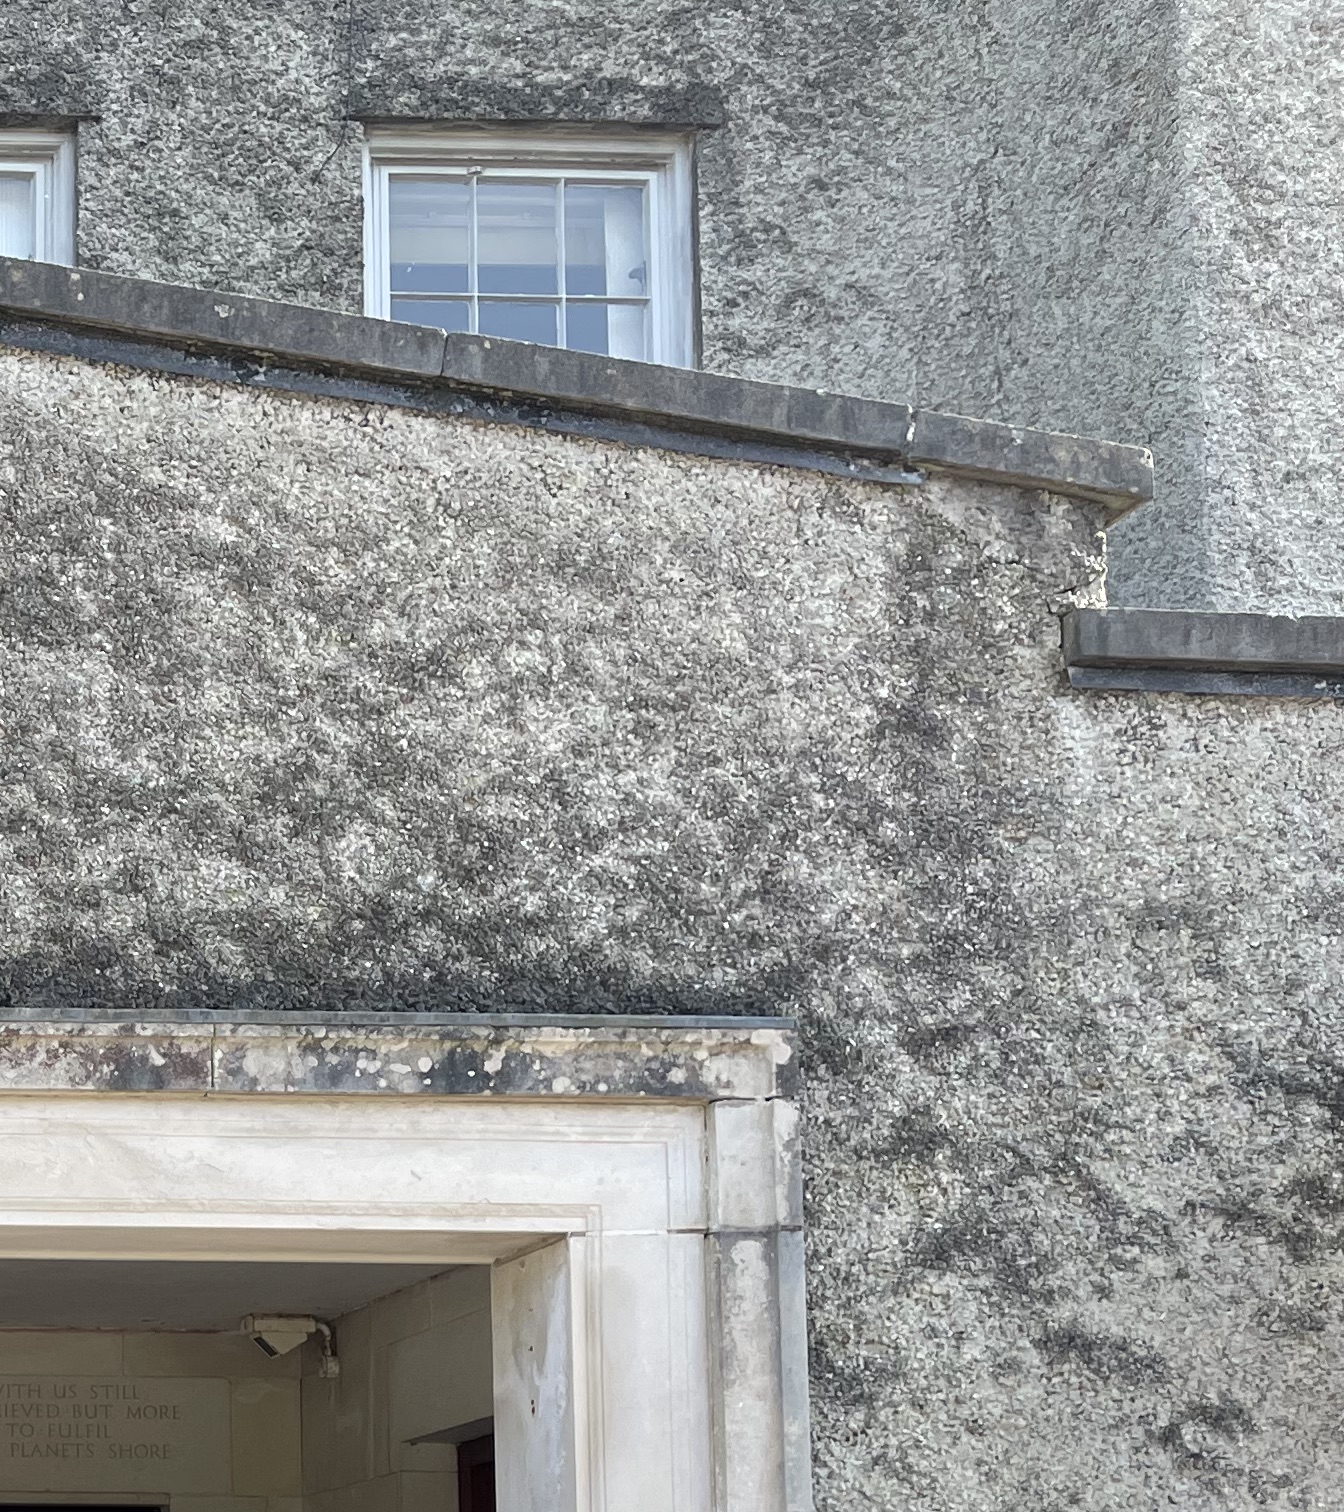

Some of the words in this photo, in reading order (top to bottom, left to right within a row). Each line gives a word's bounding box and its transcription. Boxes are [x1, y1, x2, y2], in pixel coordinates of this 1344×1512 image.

[53, 1384, 77, 1399] US
[72, 1404, 114, 1420] BUT
[126, 1405, 181, 1421] MORE
[5, 1422, 35, 1438] TO
[47, 1423, 113, 1439] FULFIL
[108, 1443, 172, 1460] SHORE
